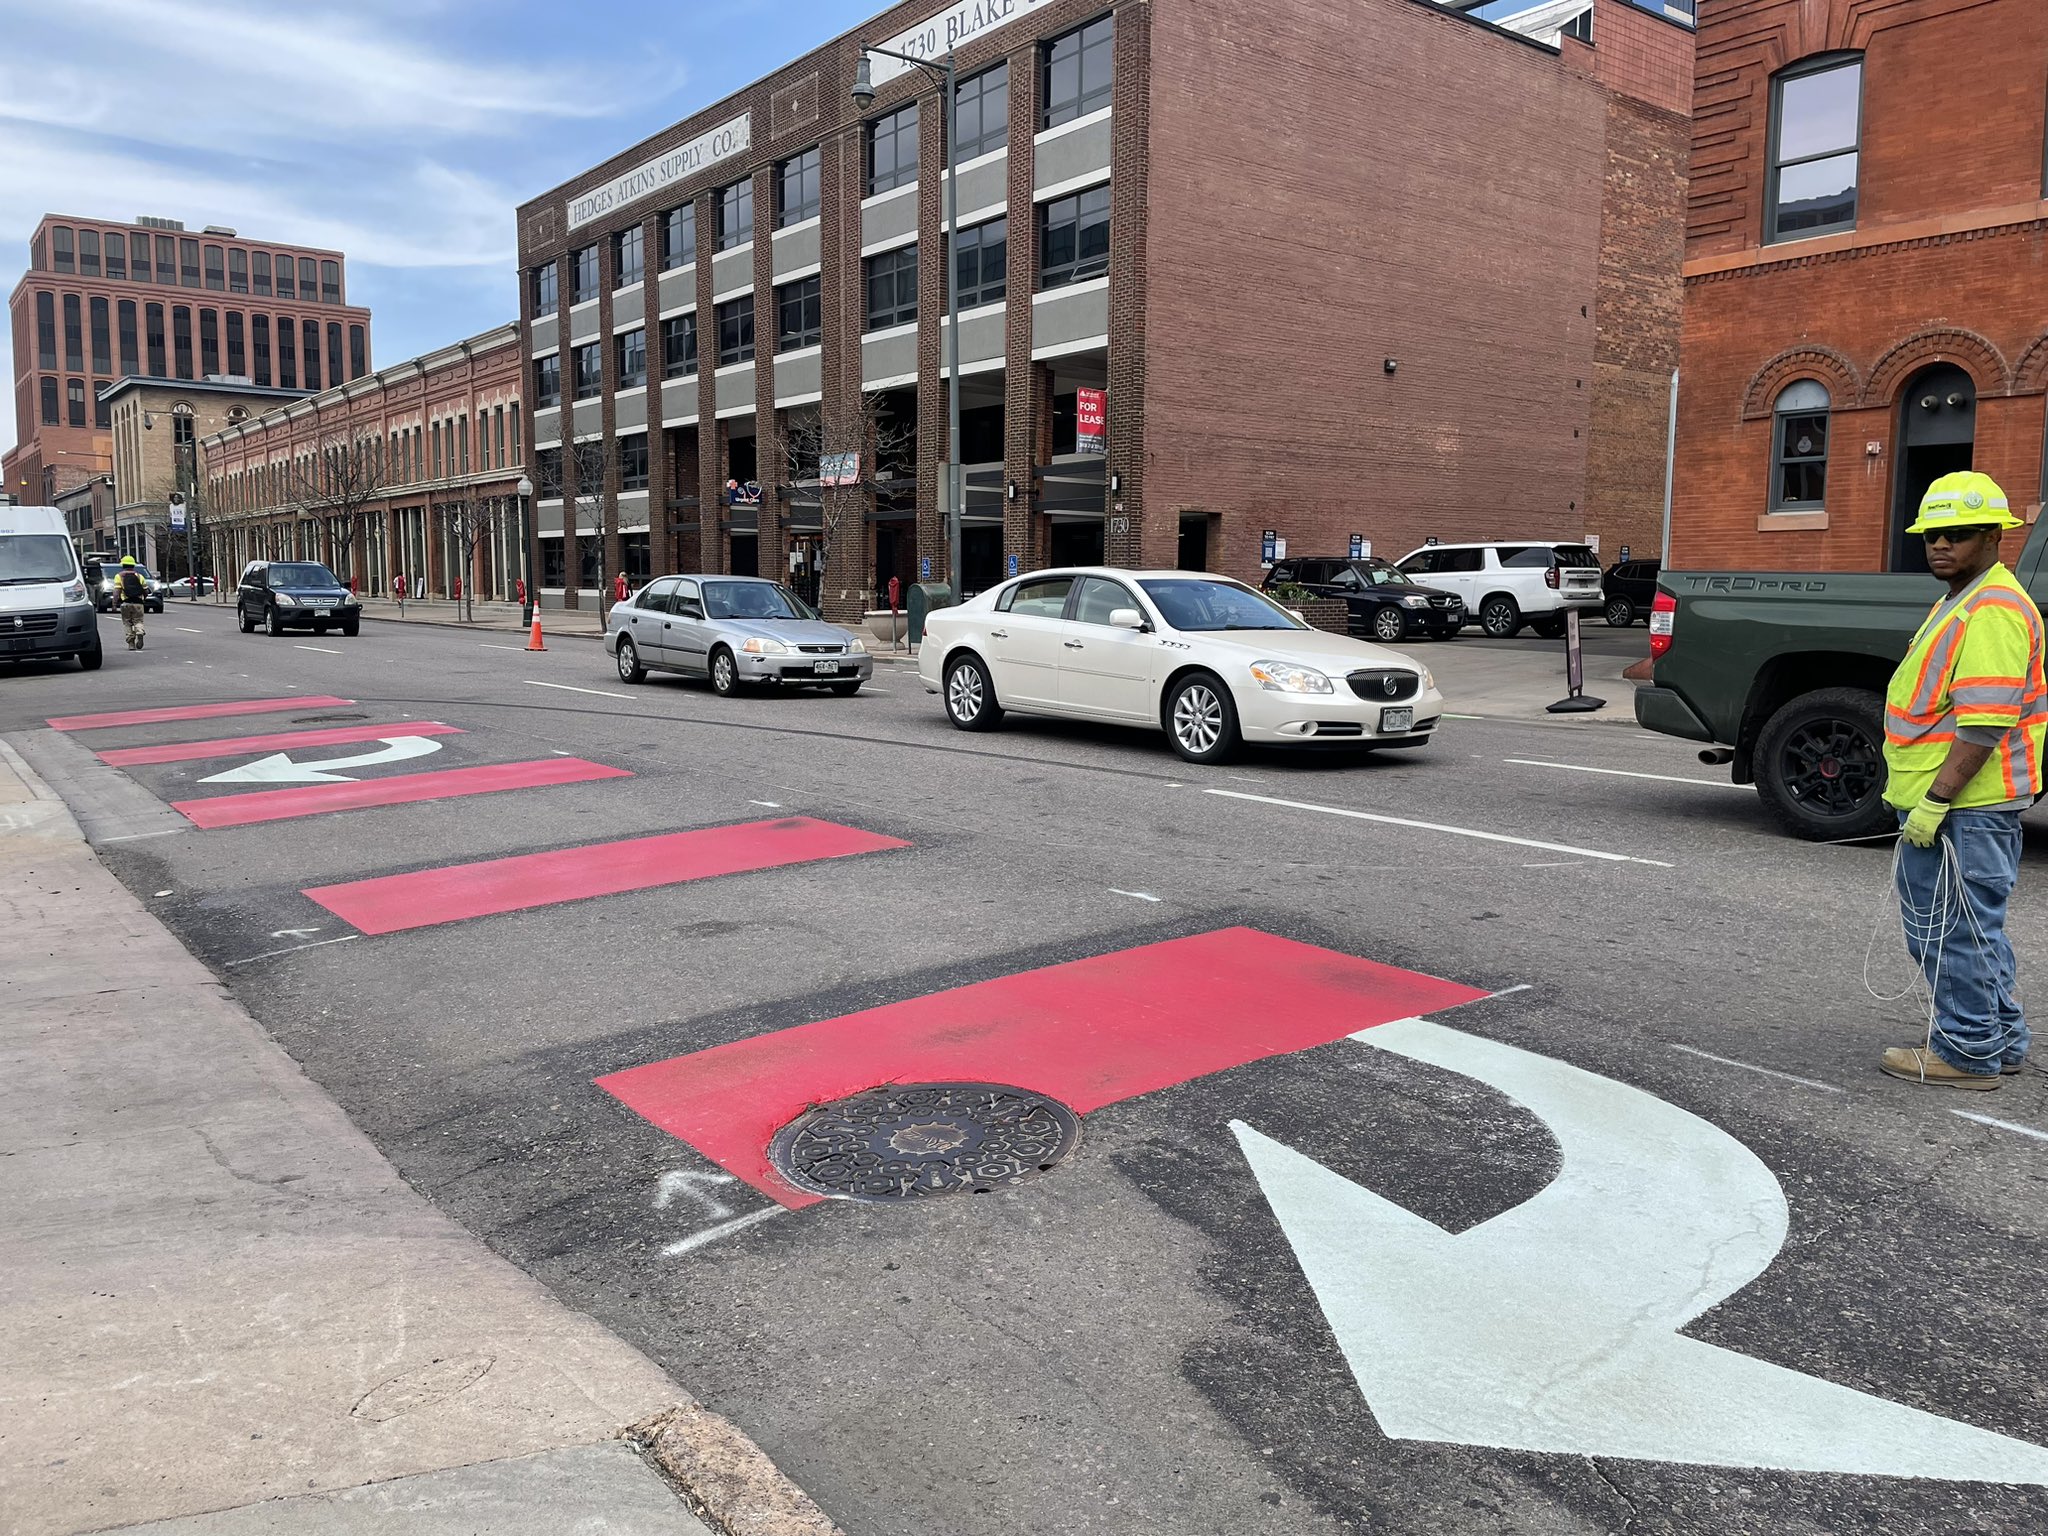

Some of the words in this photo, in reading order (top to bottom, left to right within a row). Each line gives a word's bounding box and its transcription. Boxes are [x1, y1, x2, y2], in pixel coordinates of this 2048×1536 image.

[900, 28, 936, 68] 1730
[945, 0, 1014, 45] BLAKE
[573, 188, 613, 223] HEDGES
[617, 167, 655, 201] ATKINS
[660, 143, 702, 182] SUPPLY
[712, 129, 736, 157] CO.
[1079, 401, 1097, 412] FOR
[1079, 413, 1105, 425] LEASE
[1110, 517, 1130, 534] 1730
